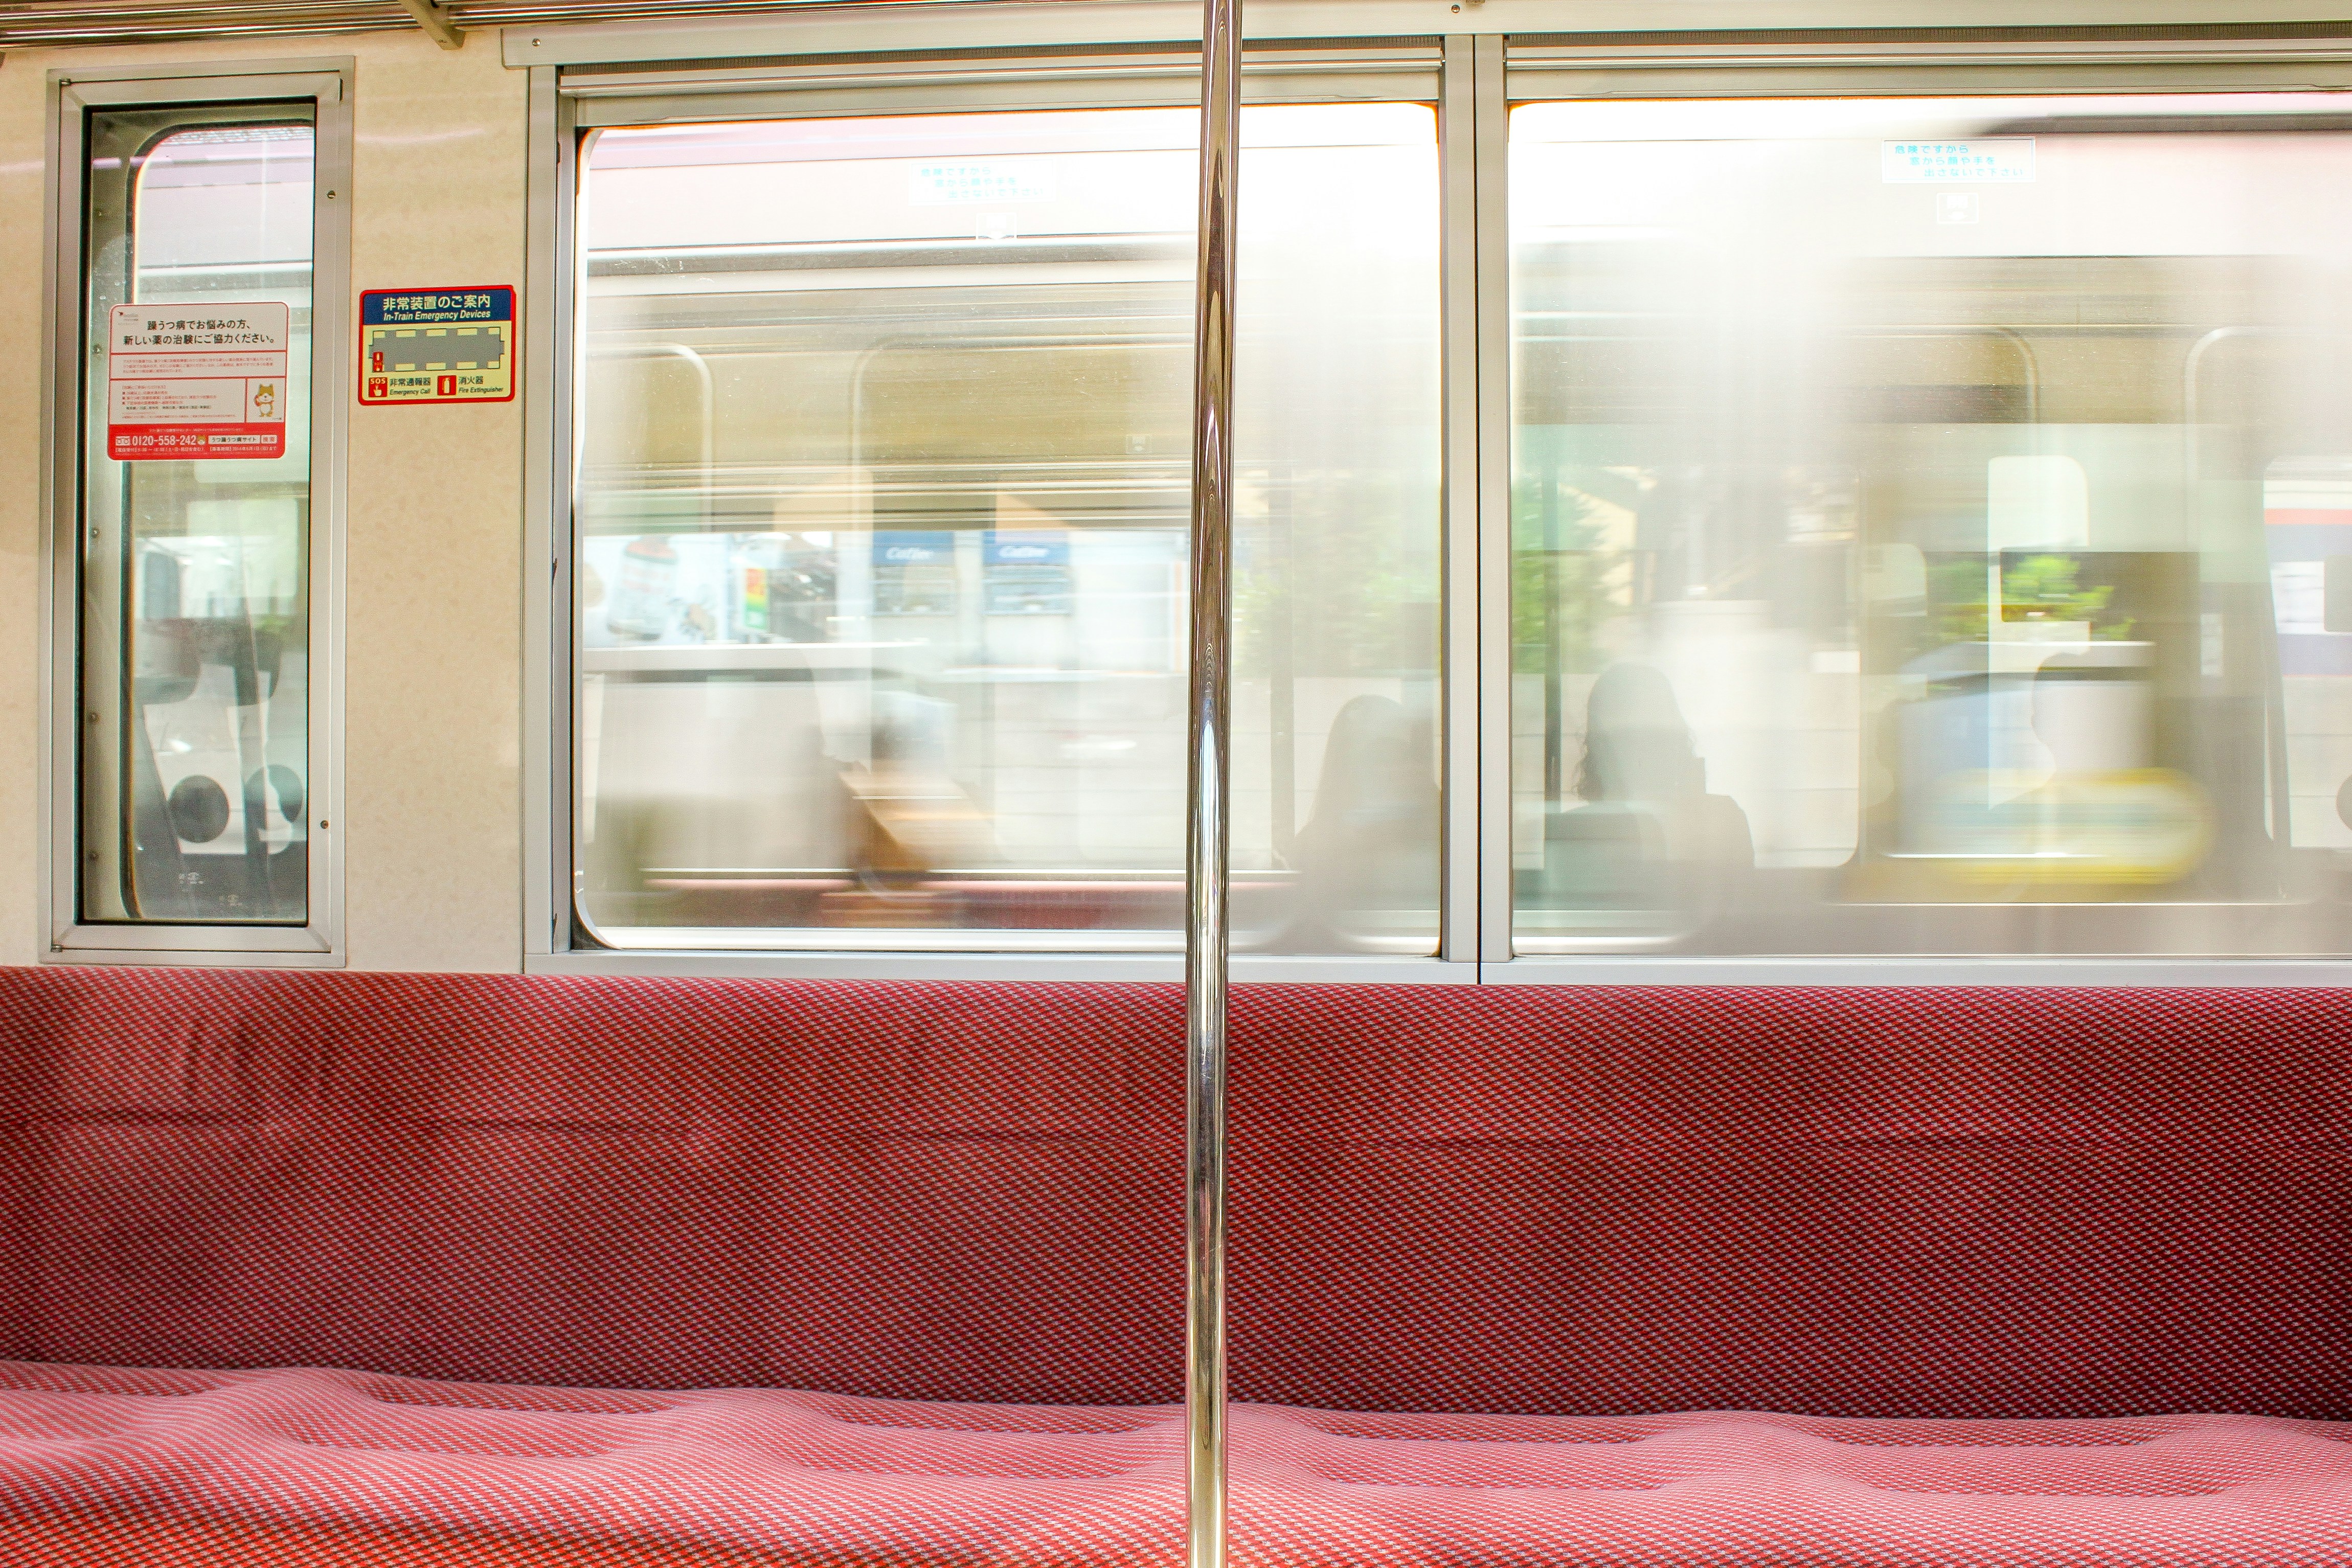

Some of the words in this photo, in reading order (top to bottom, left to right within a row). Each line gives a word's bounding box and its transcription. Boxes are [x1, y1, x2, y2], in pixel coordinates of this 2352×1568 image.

[1895, 145, 1969, 154] 危険ですから
[1910, 156, 1995, 166] 窓から顔や手を
[1924, 168, 2023, 177] 出さないで下さい
[383, 294, 491, 311] 非常装置のご案内
[383, 311, 413, 321] In-Train
[415, 311, 458, 321] Emergency
[460, 309, 491, 319] Devices
[123, 333, 275, 346] 新しい薬の治験にご協力ください。
[390, 377, 431, 387] 非常通報器
[459, 376, 484, 384] 消火器
[132, 435, 197, 446] 0120-558-242
